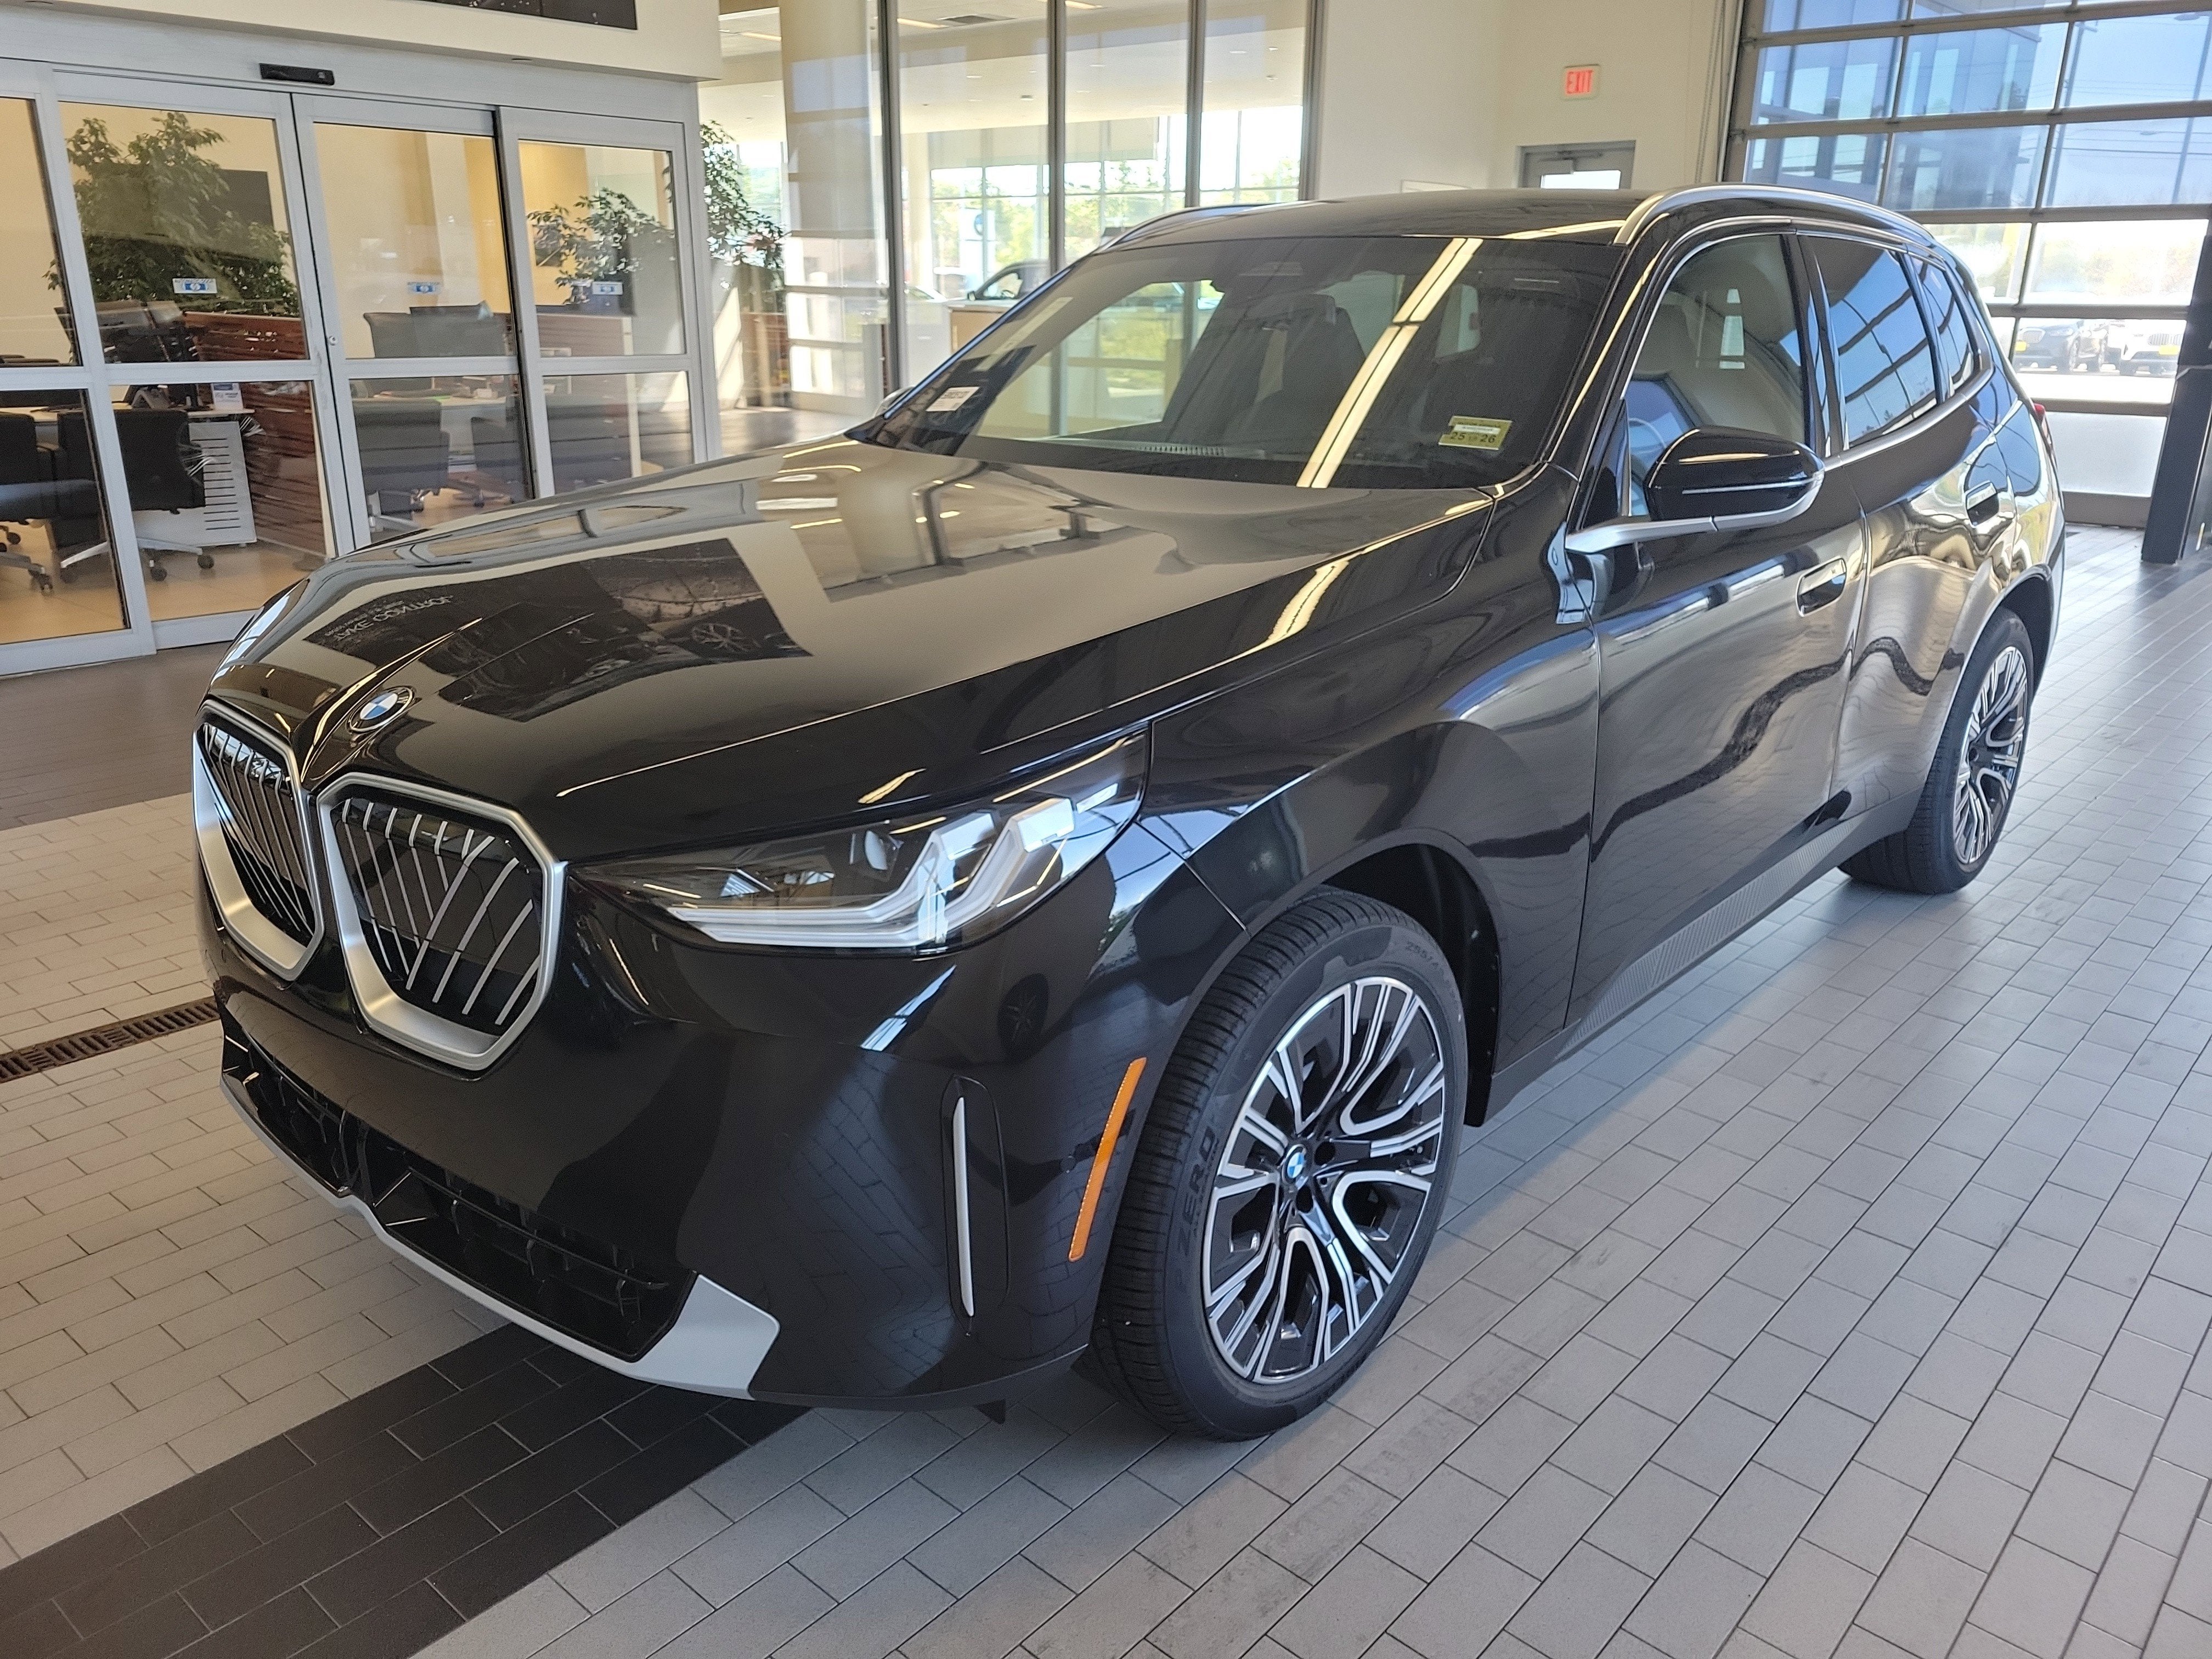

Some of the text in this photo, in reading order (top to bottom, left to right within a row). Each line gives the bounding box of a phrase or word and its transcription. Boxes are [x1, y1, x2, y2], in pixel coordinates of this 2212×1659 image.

[1567, 70, 1593, 93] EXIT
[1450, 431, 1466, 440] 25
[1480, 434, 1496, 443] 26
[1178, 1126, 1217, 1257] ZERO
